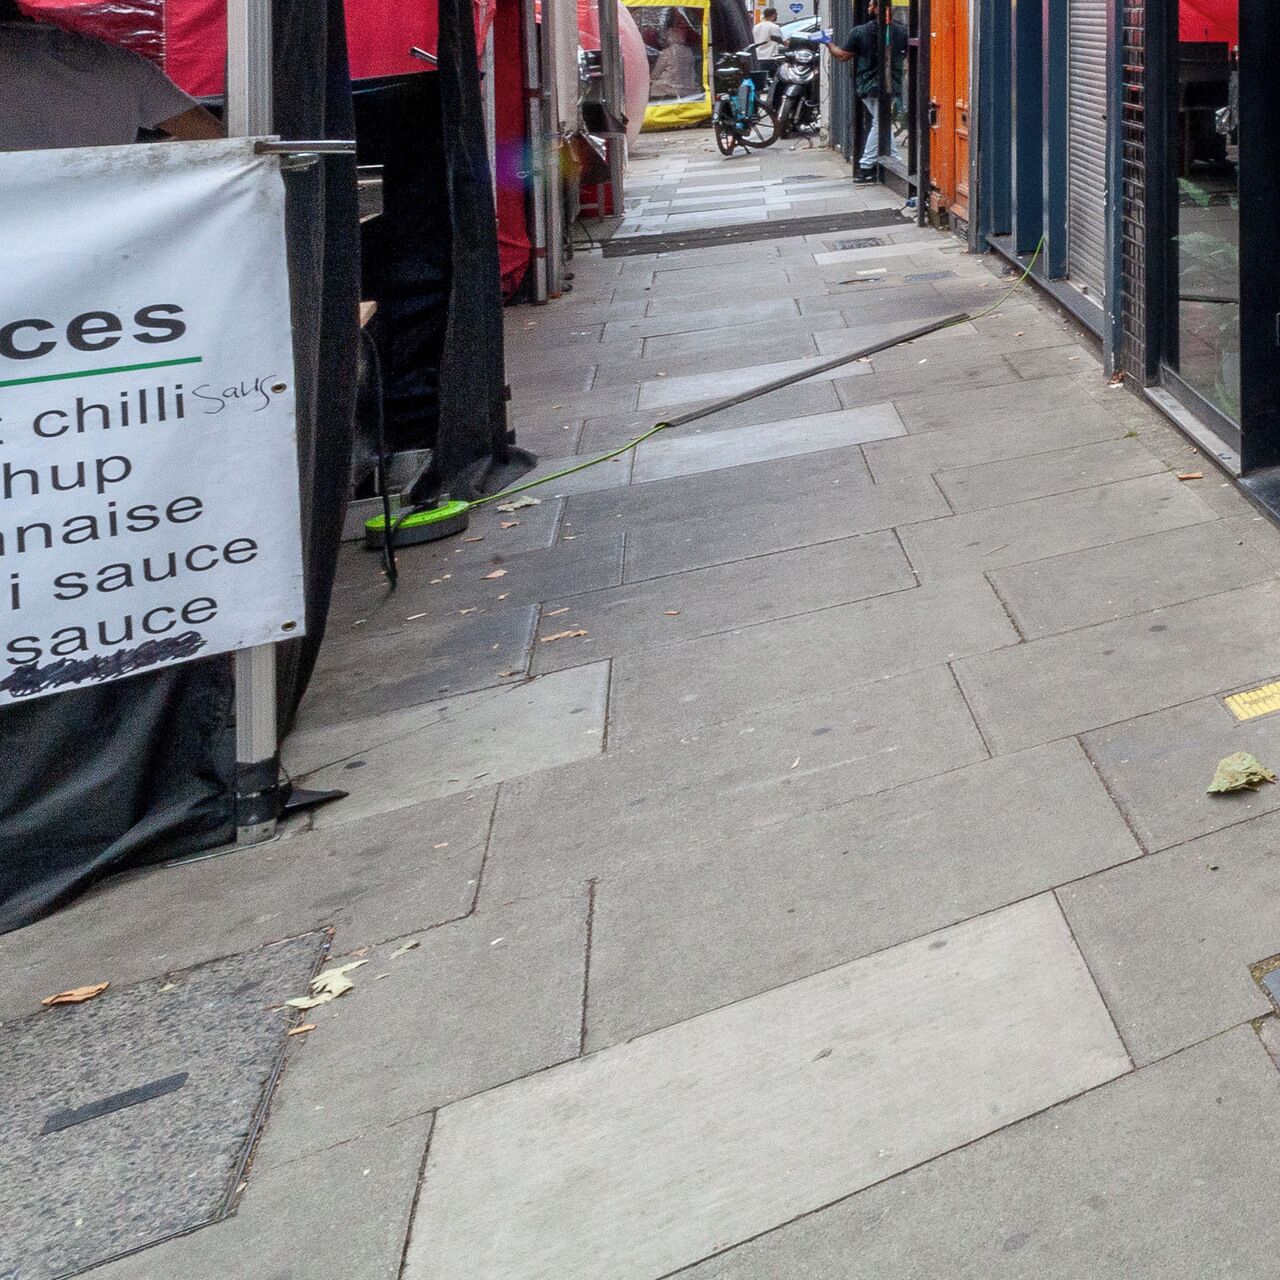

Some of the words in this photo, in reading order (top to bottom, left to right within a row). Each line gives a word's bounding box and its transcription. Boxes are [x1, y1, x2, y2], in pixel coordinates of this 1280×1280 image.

[0, 303, 187, 360] ces
[33, 384, 185, 438] chilli
[3, 455, 132, 499] hup
[0, 496, 203, 556] naise
[53, 537, 258, 601] sauce
[6, 596, 218, 665] sauce
